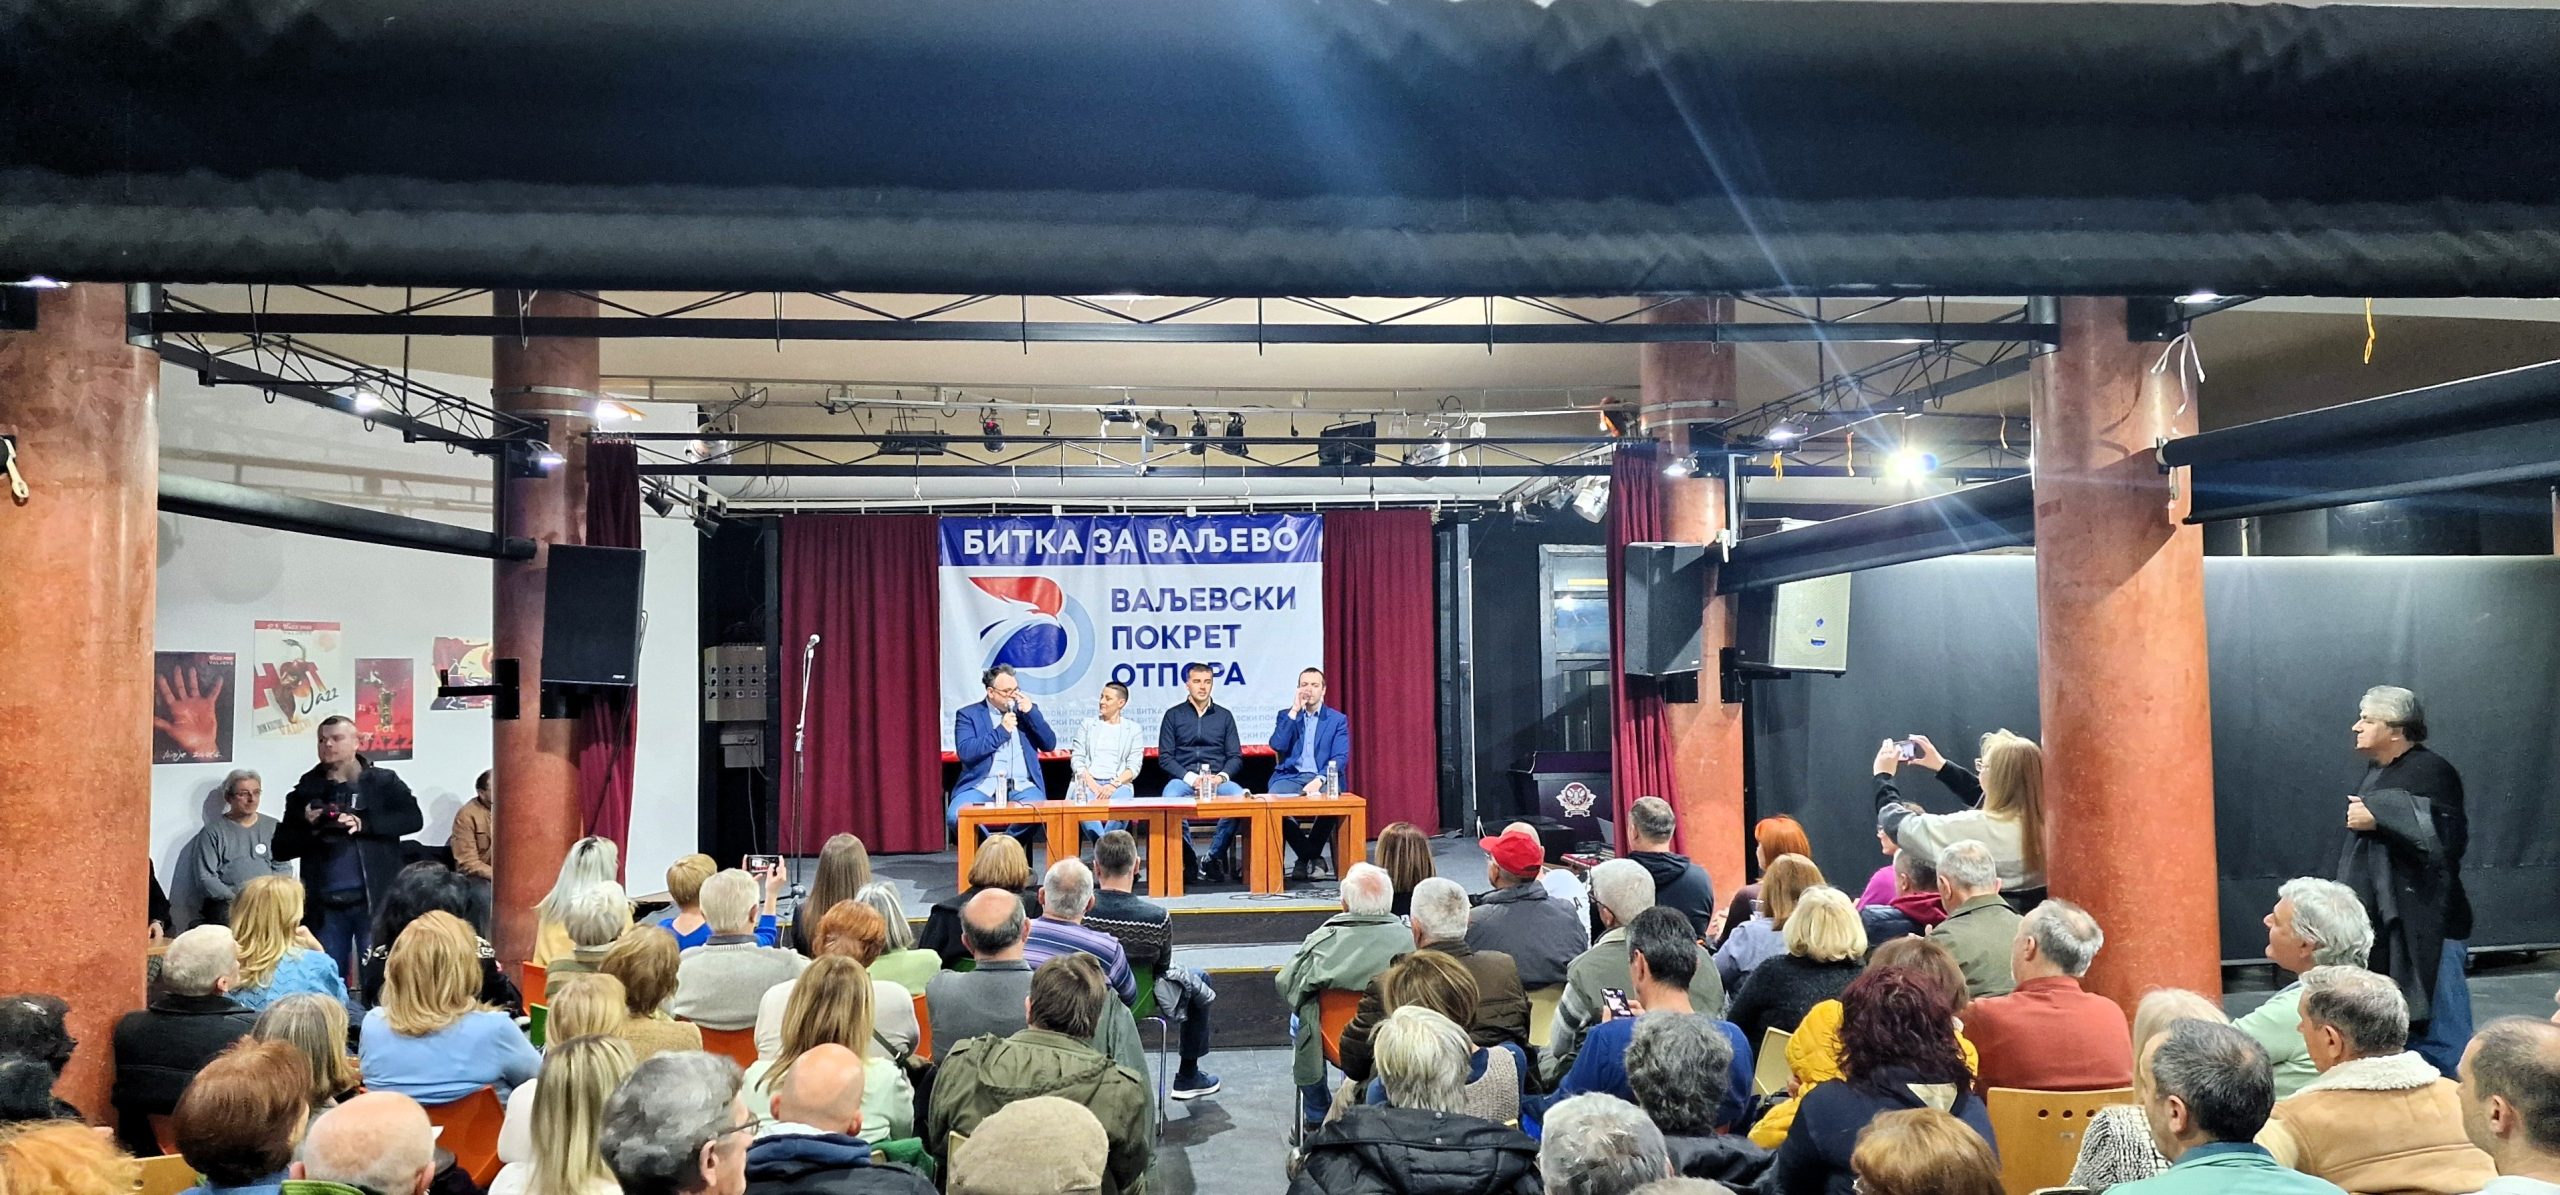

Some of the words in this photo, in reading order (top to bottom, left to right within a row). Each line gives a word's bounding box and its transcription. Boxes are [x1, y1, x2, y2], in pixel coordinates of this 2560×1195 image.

[963, 529, 1083, 555] БИТКА
[1092, 528, 1138, 554] ЗА
[1147, 526, 1299, 553] ВАЉЕВО
[1111, 586, 1296, 612] ВАЉЕВСКИ
[1112, 624, 1242, 650] ПОКРЕТ
[301, 687, 339, 714] Jazz
